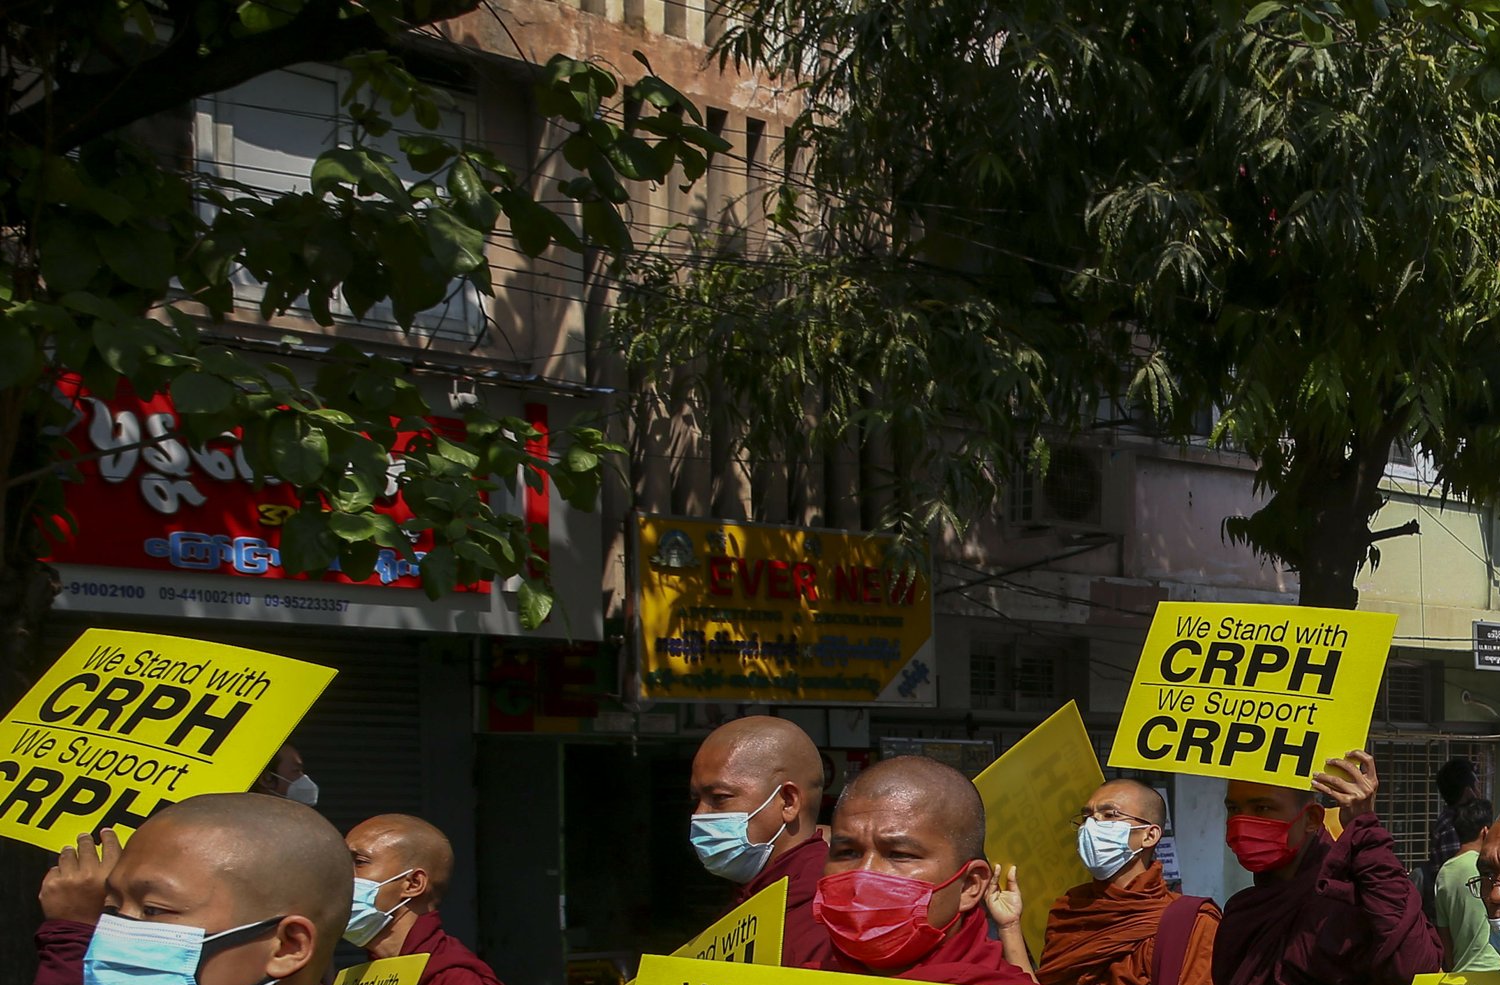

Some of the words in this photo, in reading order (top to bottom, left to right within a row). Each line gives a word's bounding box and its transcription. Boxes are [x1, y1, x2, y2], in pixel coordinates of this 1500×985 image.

[63, 580, 146, 600] -91002100
[159, 587, 252, 607] 09-441002100
[709, 556, 820, 602] EVER
[1176, 616, 1211, 638] We
[1217, 617, 1290, 642] Stand
[1296, 623, 1348, 648] with
[83, 645, 126, 673] We
[125, 650, 212, 685] Stand
[206, 667, 271, 700] with
[1159, 639, 1343, 695] CRPH
[39, 672, 253, 757] CRPH
[1158, 688, 1195, 713] We
[1204, 691, 1318, 725] Support
[11, 728, 57, 758] We
[58, 736, 190, 792] Support
[1136, 715, 1320, 778] CRPH
[722, 914, 758, 955] with
